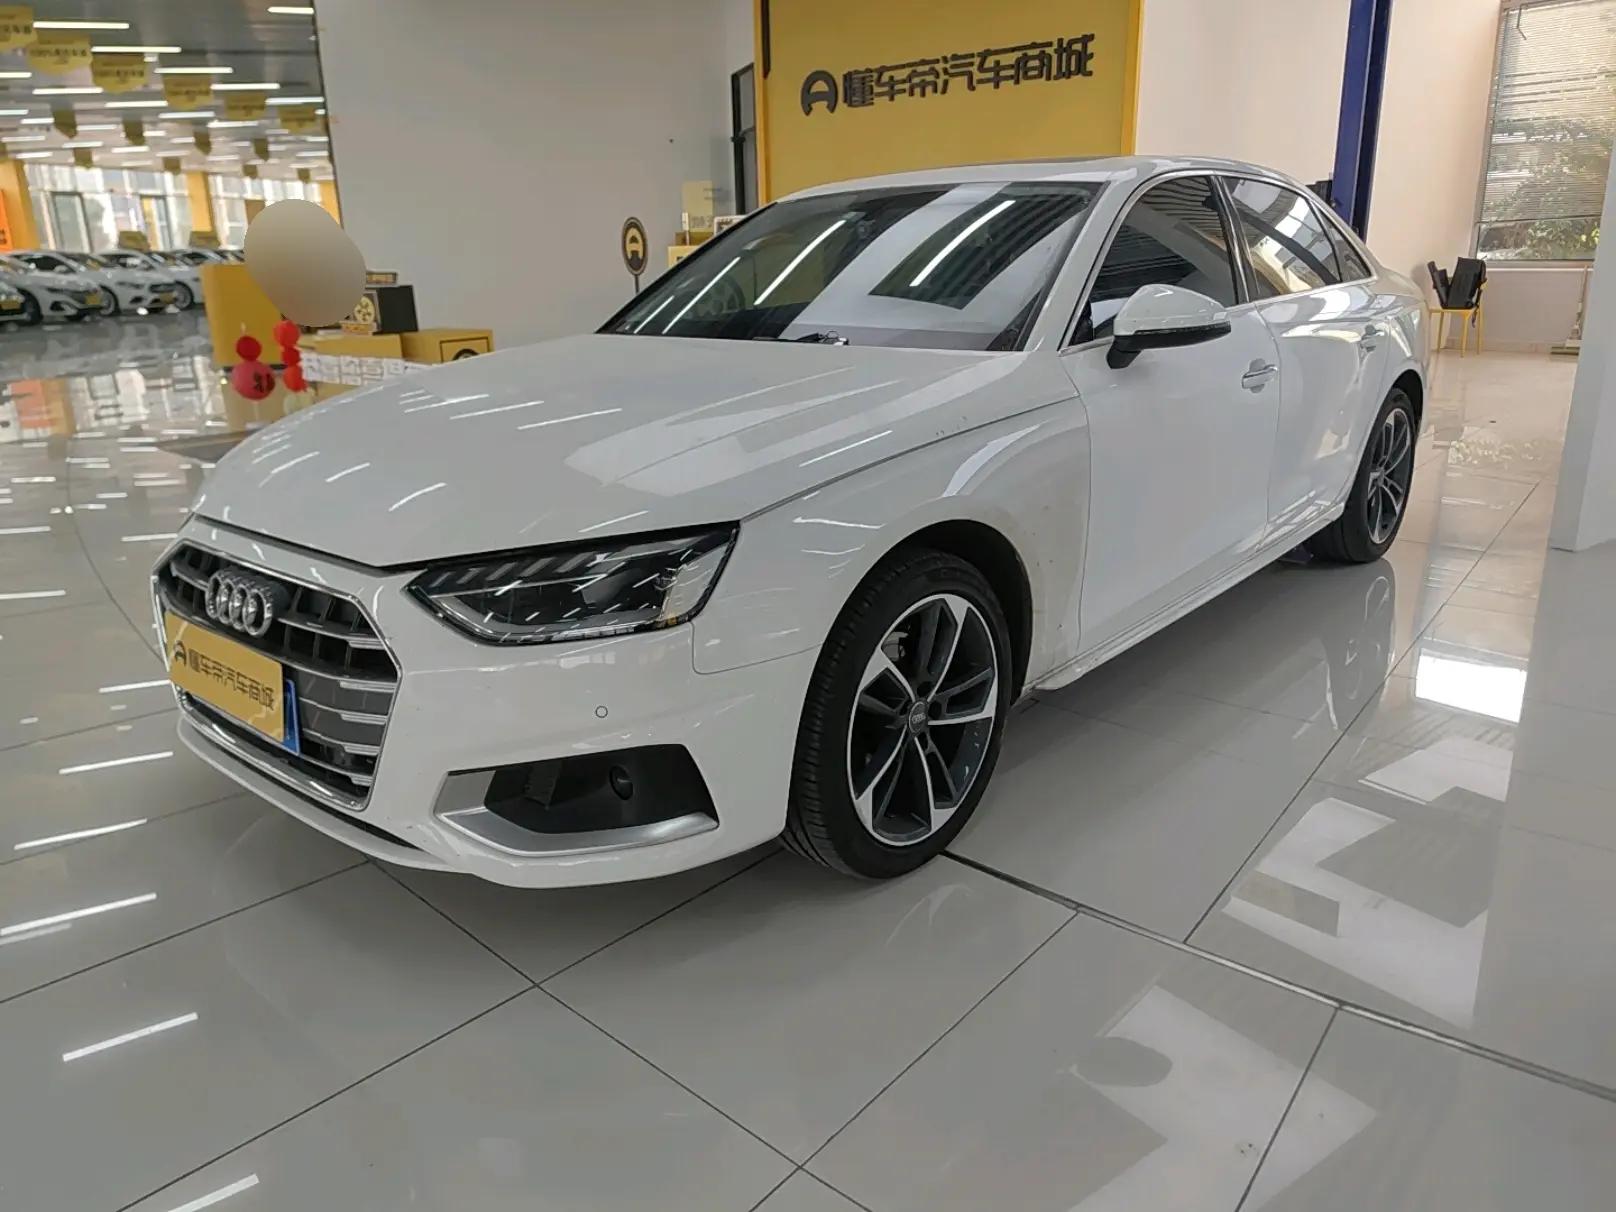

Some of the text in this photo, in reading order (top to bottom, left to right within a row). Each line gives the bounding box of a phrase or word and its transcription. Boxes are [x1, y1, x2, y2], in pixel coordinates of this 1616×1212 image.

[842, 33, 1095, 107] 懂车帝汽车商城
